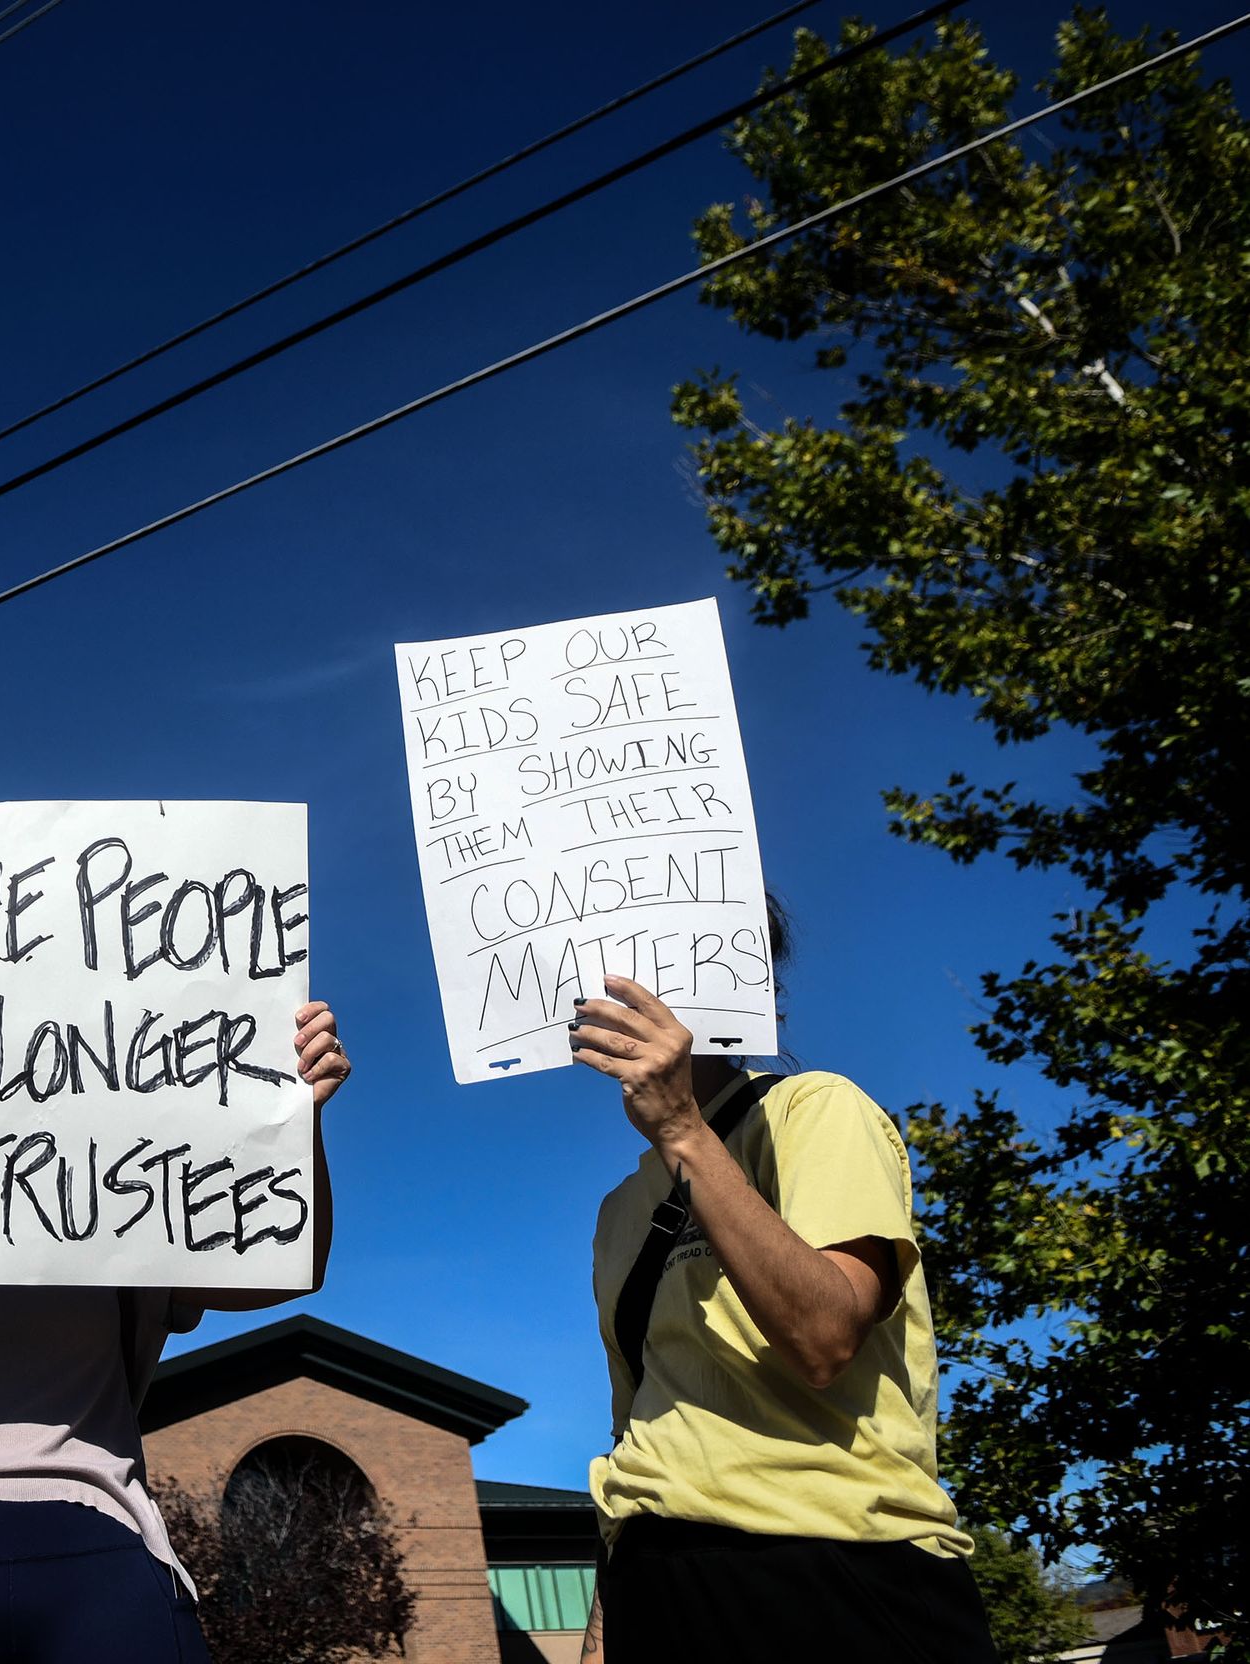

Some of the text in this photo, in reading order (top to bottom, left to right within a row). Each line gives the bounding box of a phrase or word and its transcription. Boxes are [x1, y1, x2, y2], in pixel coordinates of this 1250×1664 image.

[408, 622, 667, 702] KEEP OUR
[416, 672, 697, 759] KIDS SAFE
[427, 732, 717, 821] BY SHOWING
[426, 783, 732, 869] THEM THEIR
[75, 836, 308, 981] PEOPLE
[470, 846, 739, 942] CONSENT
